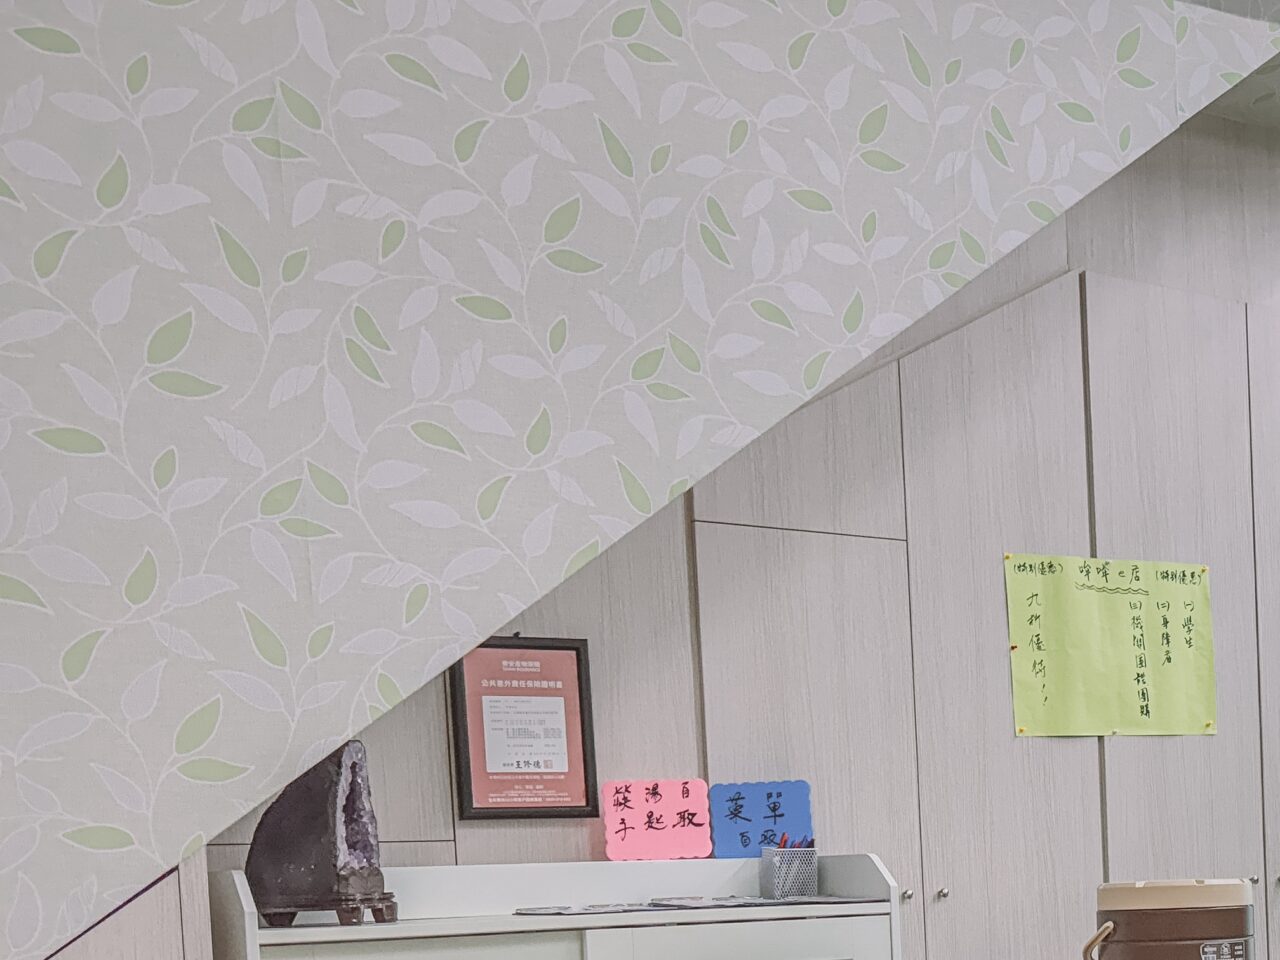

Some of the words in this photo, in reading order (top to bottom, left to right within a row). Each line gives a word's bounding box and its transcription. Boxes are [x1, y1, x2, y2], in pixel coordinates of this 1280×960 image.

[614, 784, 636, 841] 筷子
[644, 785, 667, 831] 湯匙
[672, 781, 705, 828] 自取
[724, 791, 785, 826] 菜單
[738, 829, 781, 849] 自取
